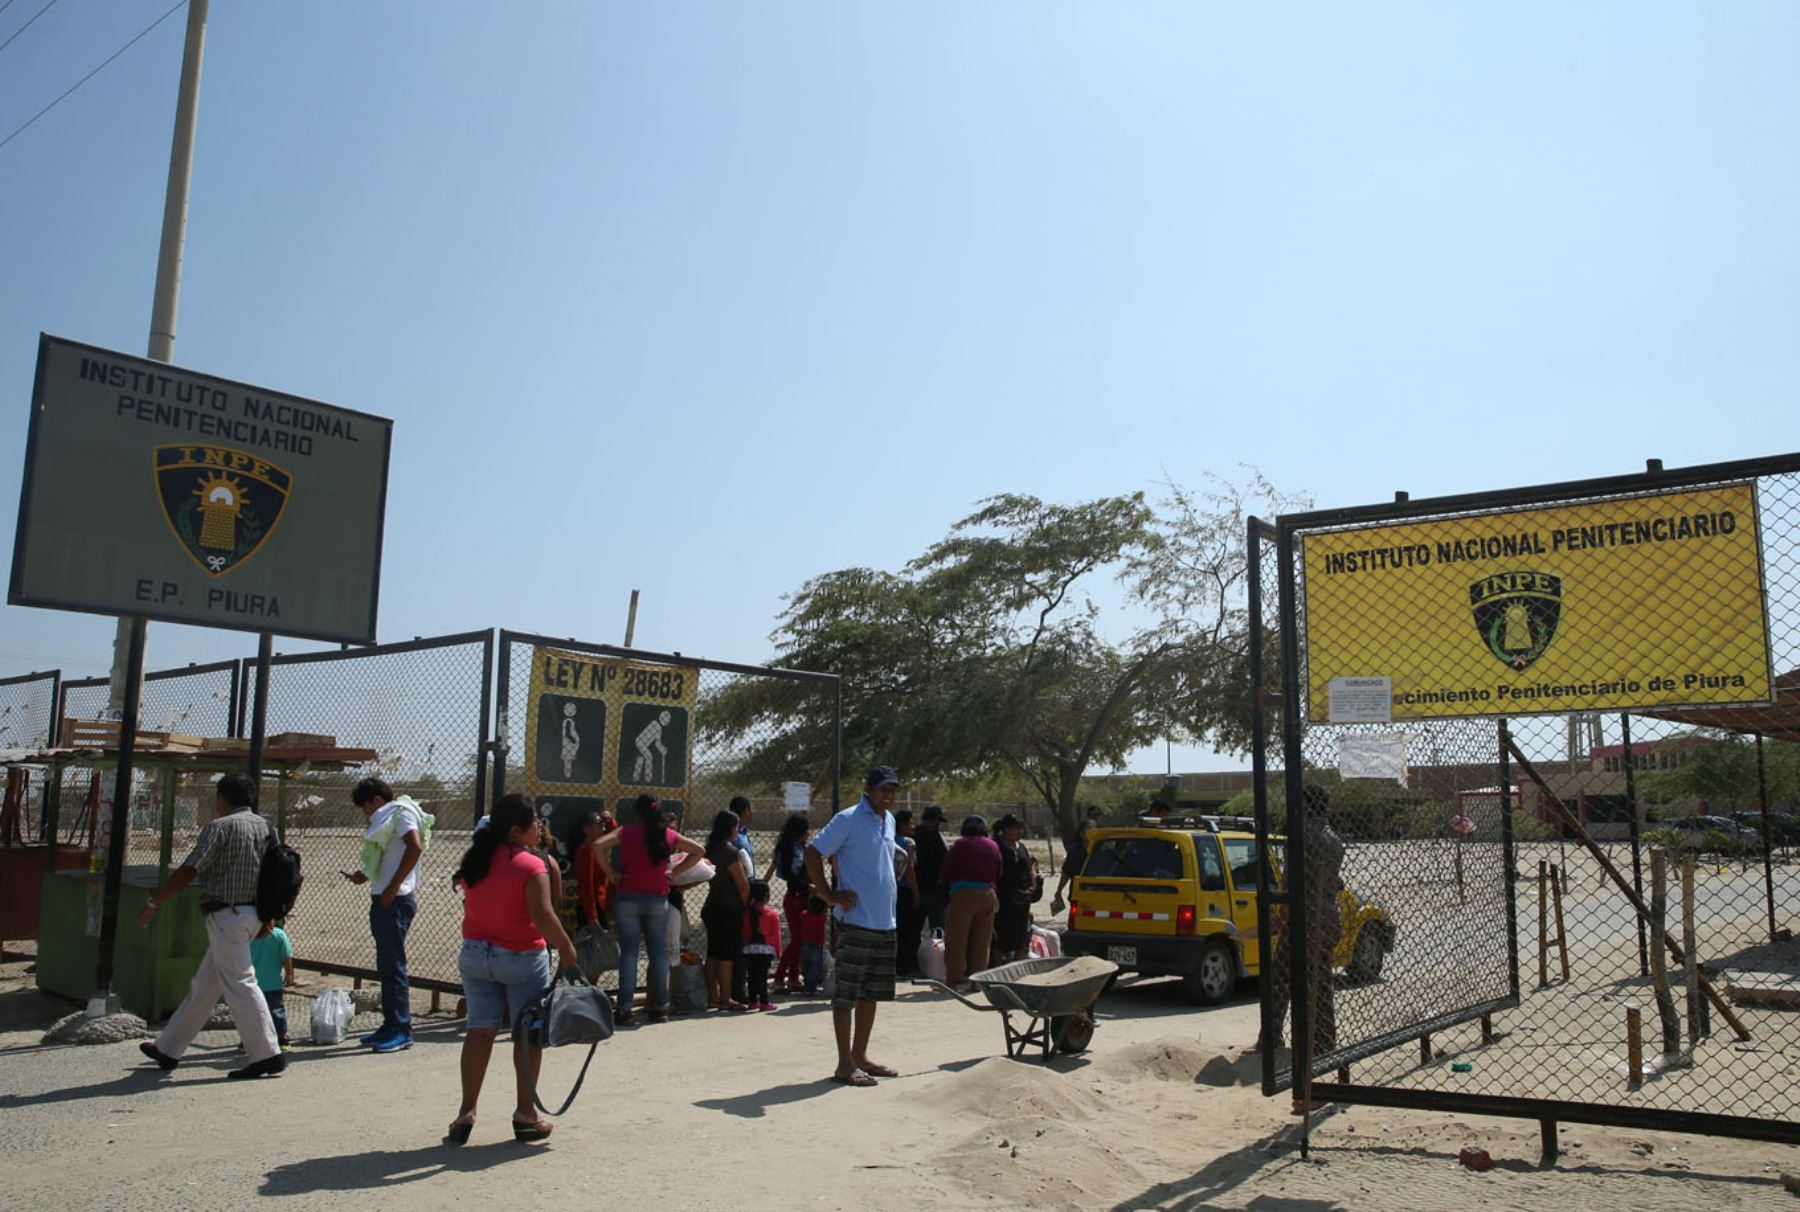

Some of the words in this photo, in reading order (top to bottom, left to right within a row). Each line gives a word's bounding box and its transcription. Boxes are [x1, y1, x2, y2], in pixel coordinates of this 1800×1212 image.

[79, 357, 228, 412] INSTITUTO
[243, 396, 360, 442] NACIONAL
[117, 394, 313, 456] PENITENCIARIO
[178, 447, 272, 480] INPE
[1325, 543, 1431, 575] INSTITUTO
[1437, 532, 1546, 564] NACIONAL
[1552, 511, 1736, 552] PENITENCIARIO
[136, 578, 184, 606] E.P.
[207, 588, 281, 618] PIURA
[1480, 573, 1551, 599] INPE
[544, 655, 584, 690] LEY
[622, 667, 684, 700] 28683
[1393, 687, 1491, 705] ecimiento
[1497, 678, 1641, 700] Penitenciario
[1648, 675, 1677, 692] de
[1684, 673, 1746, 690] Piura
